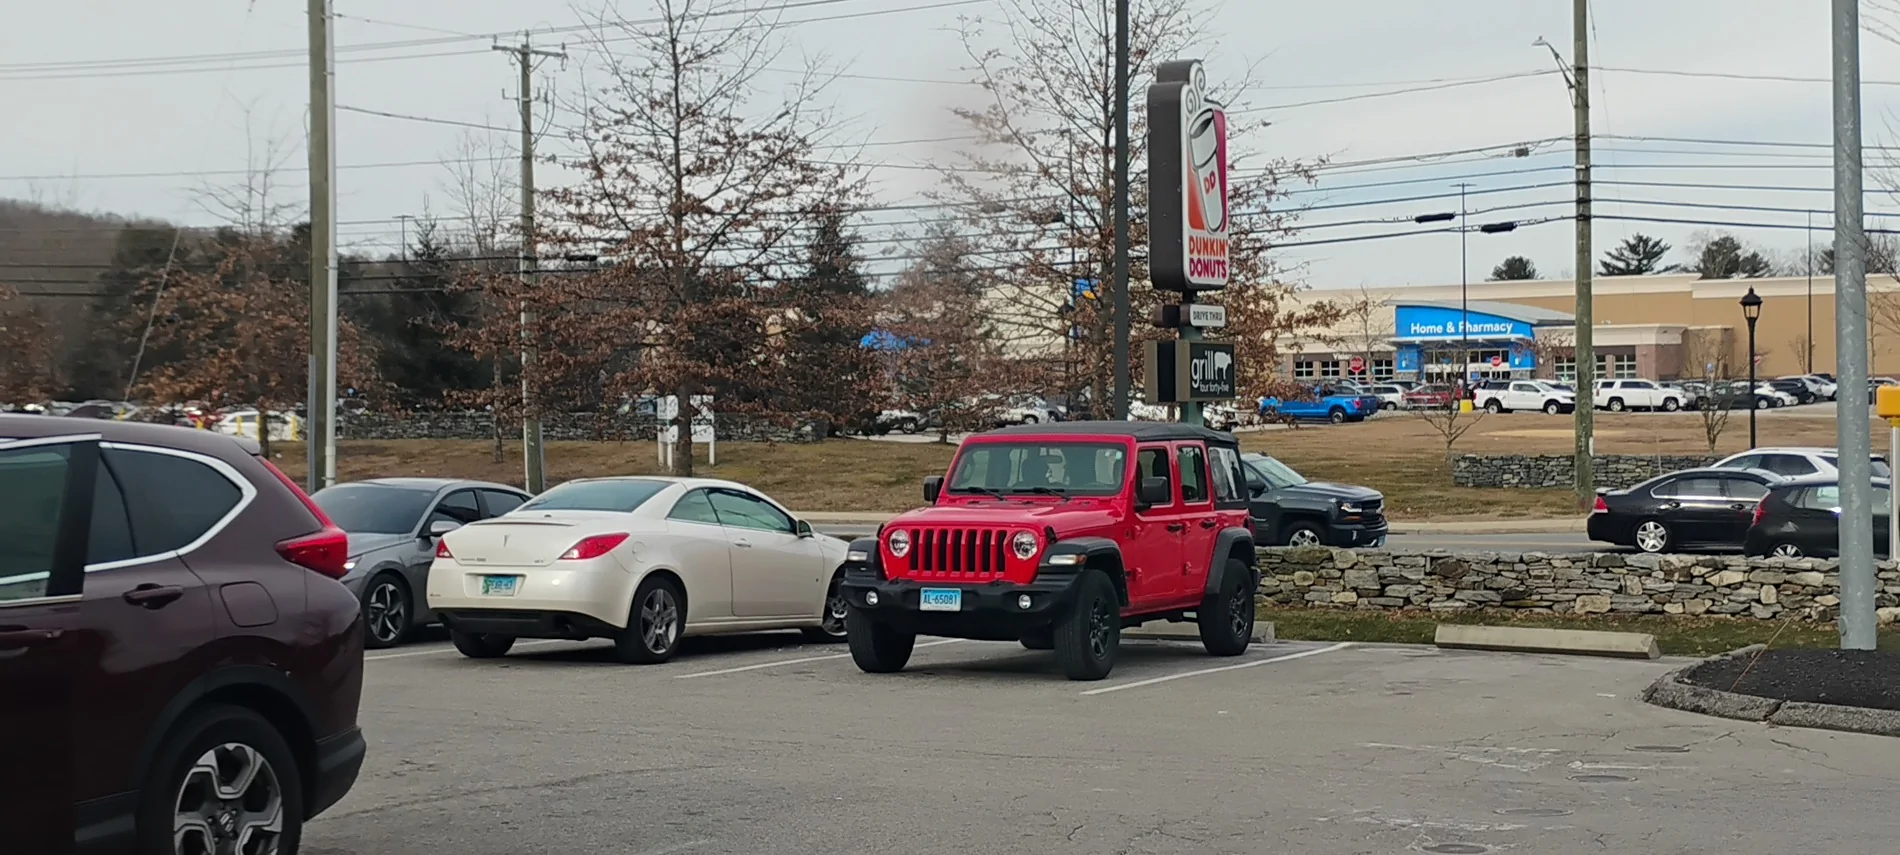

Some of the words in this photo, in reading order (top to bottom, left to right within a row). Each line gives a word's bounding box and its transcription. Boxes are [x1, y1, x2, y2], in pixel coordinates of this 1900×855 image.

[1204, 170, 1216, 194] DD
[1189, 257, 1227, 280] DONUTS
[1410, 322, 1443, 335] Home
[1446, 321, 1455, 333] &
[1458, 320, 1513, 335] Pharmacy
[1191, 350, 1214, 388] grill
